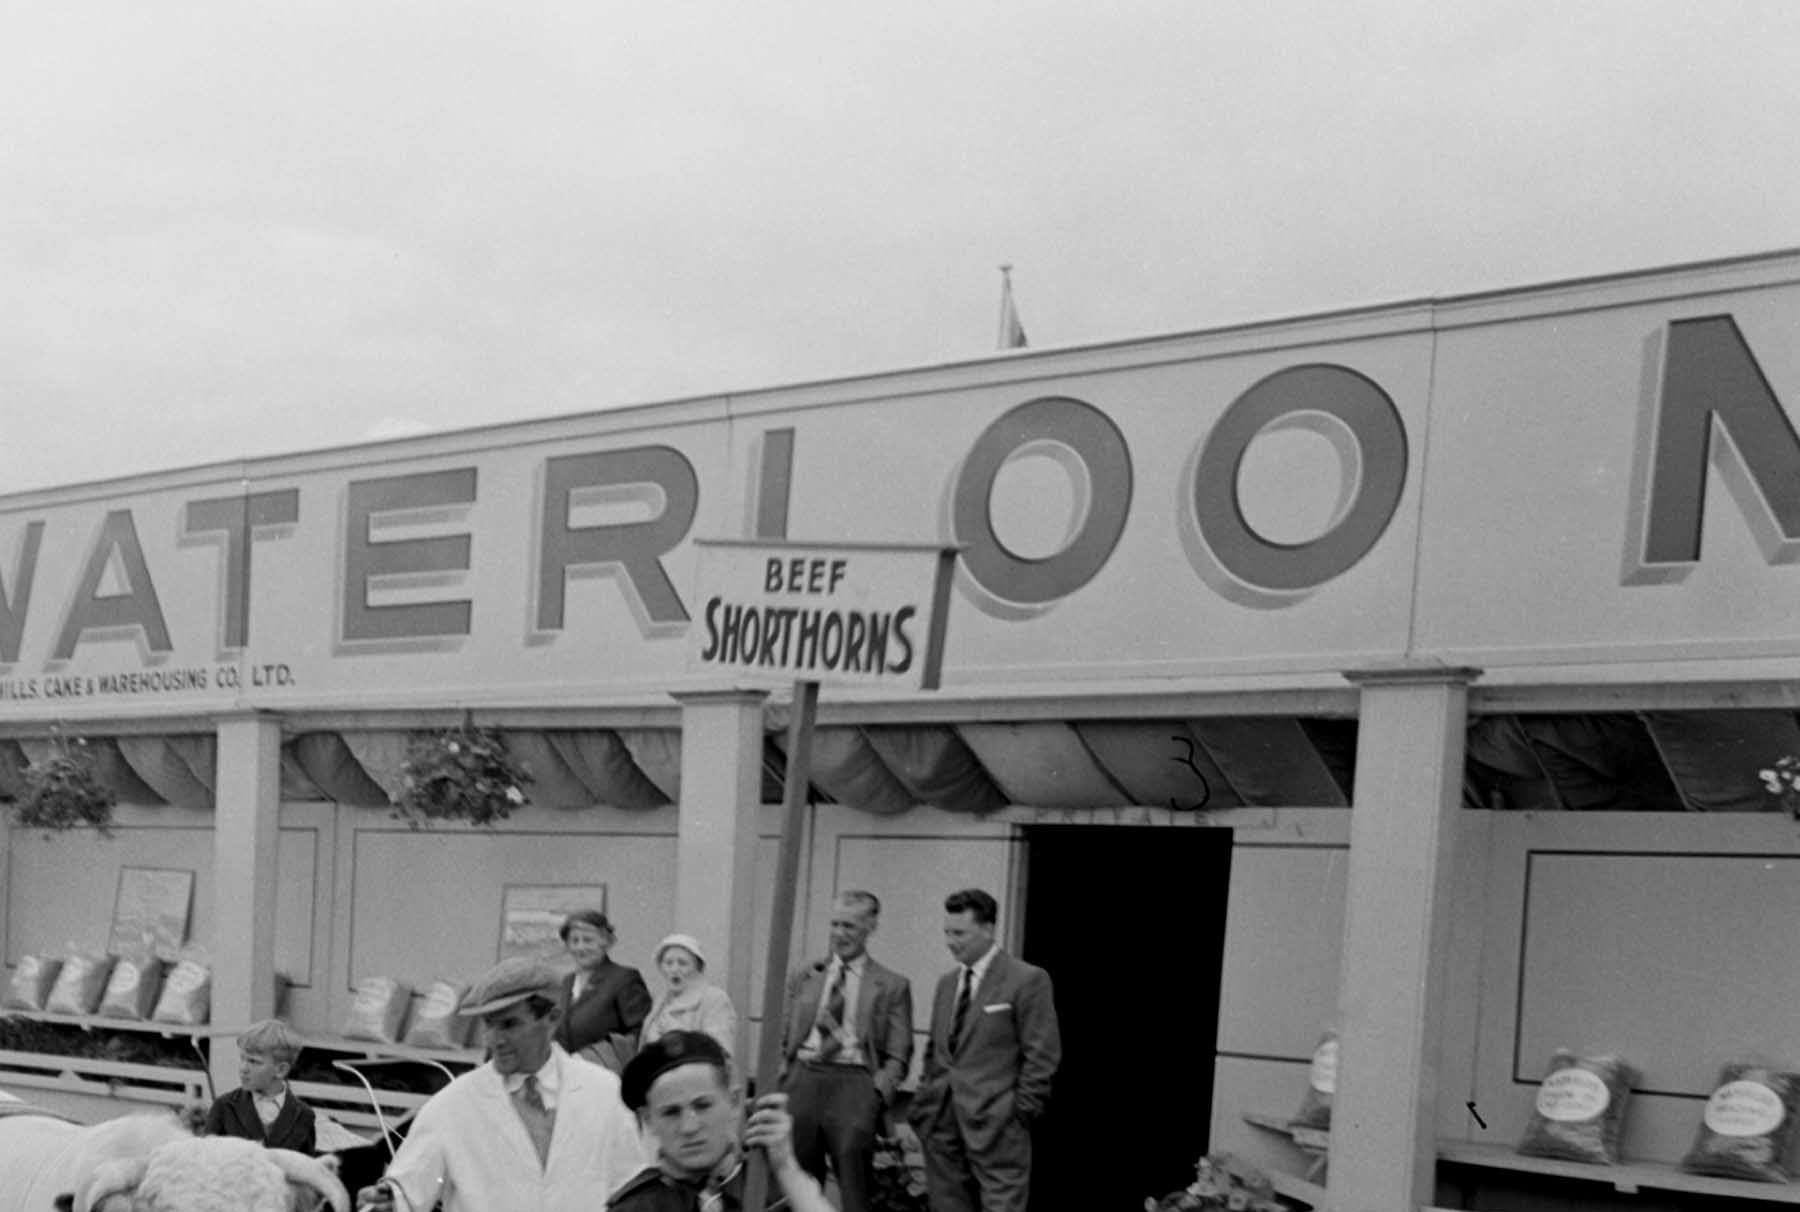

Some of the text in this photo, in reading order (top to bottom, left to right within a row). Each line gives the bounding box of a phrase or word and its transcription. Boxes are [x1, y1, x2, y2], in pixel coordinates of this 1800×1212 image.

[764, 557, 848, 594] BEEF
[702, 597, 917, 675] SHORTHORNS
[44, 675, 82, 698] CAKE
[85, 677, 94, 696] &
[98, 667, 208, 695] WAREHOUSING
[252, 663, 297, 688] LTD.
